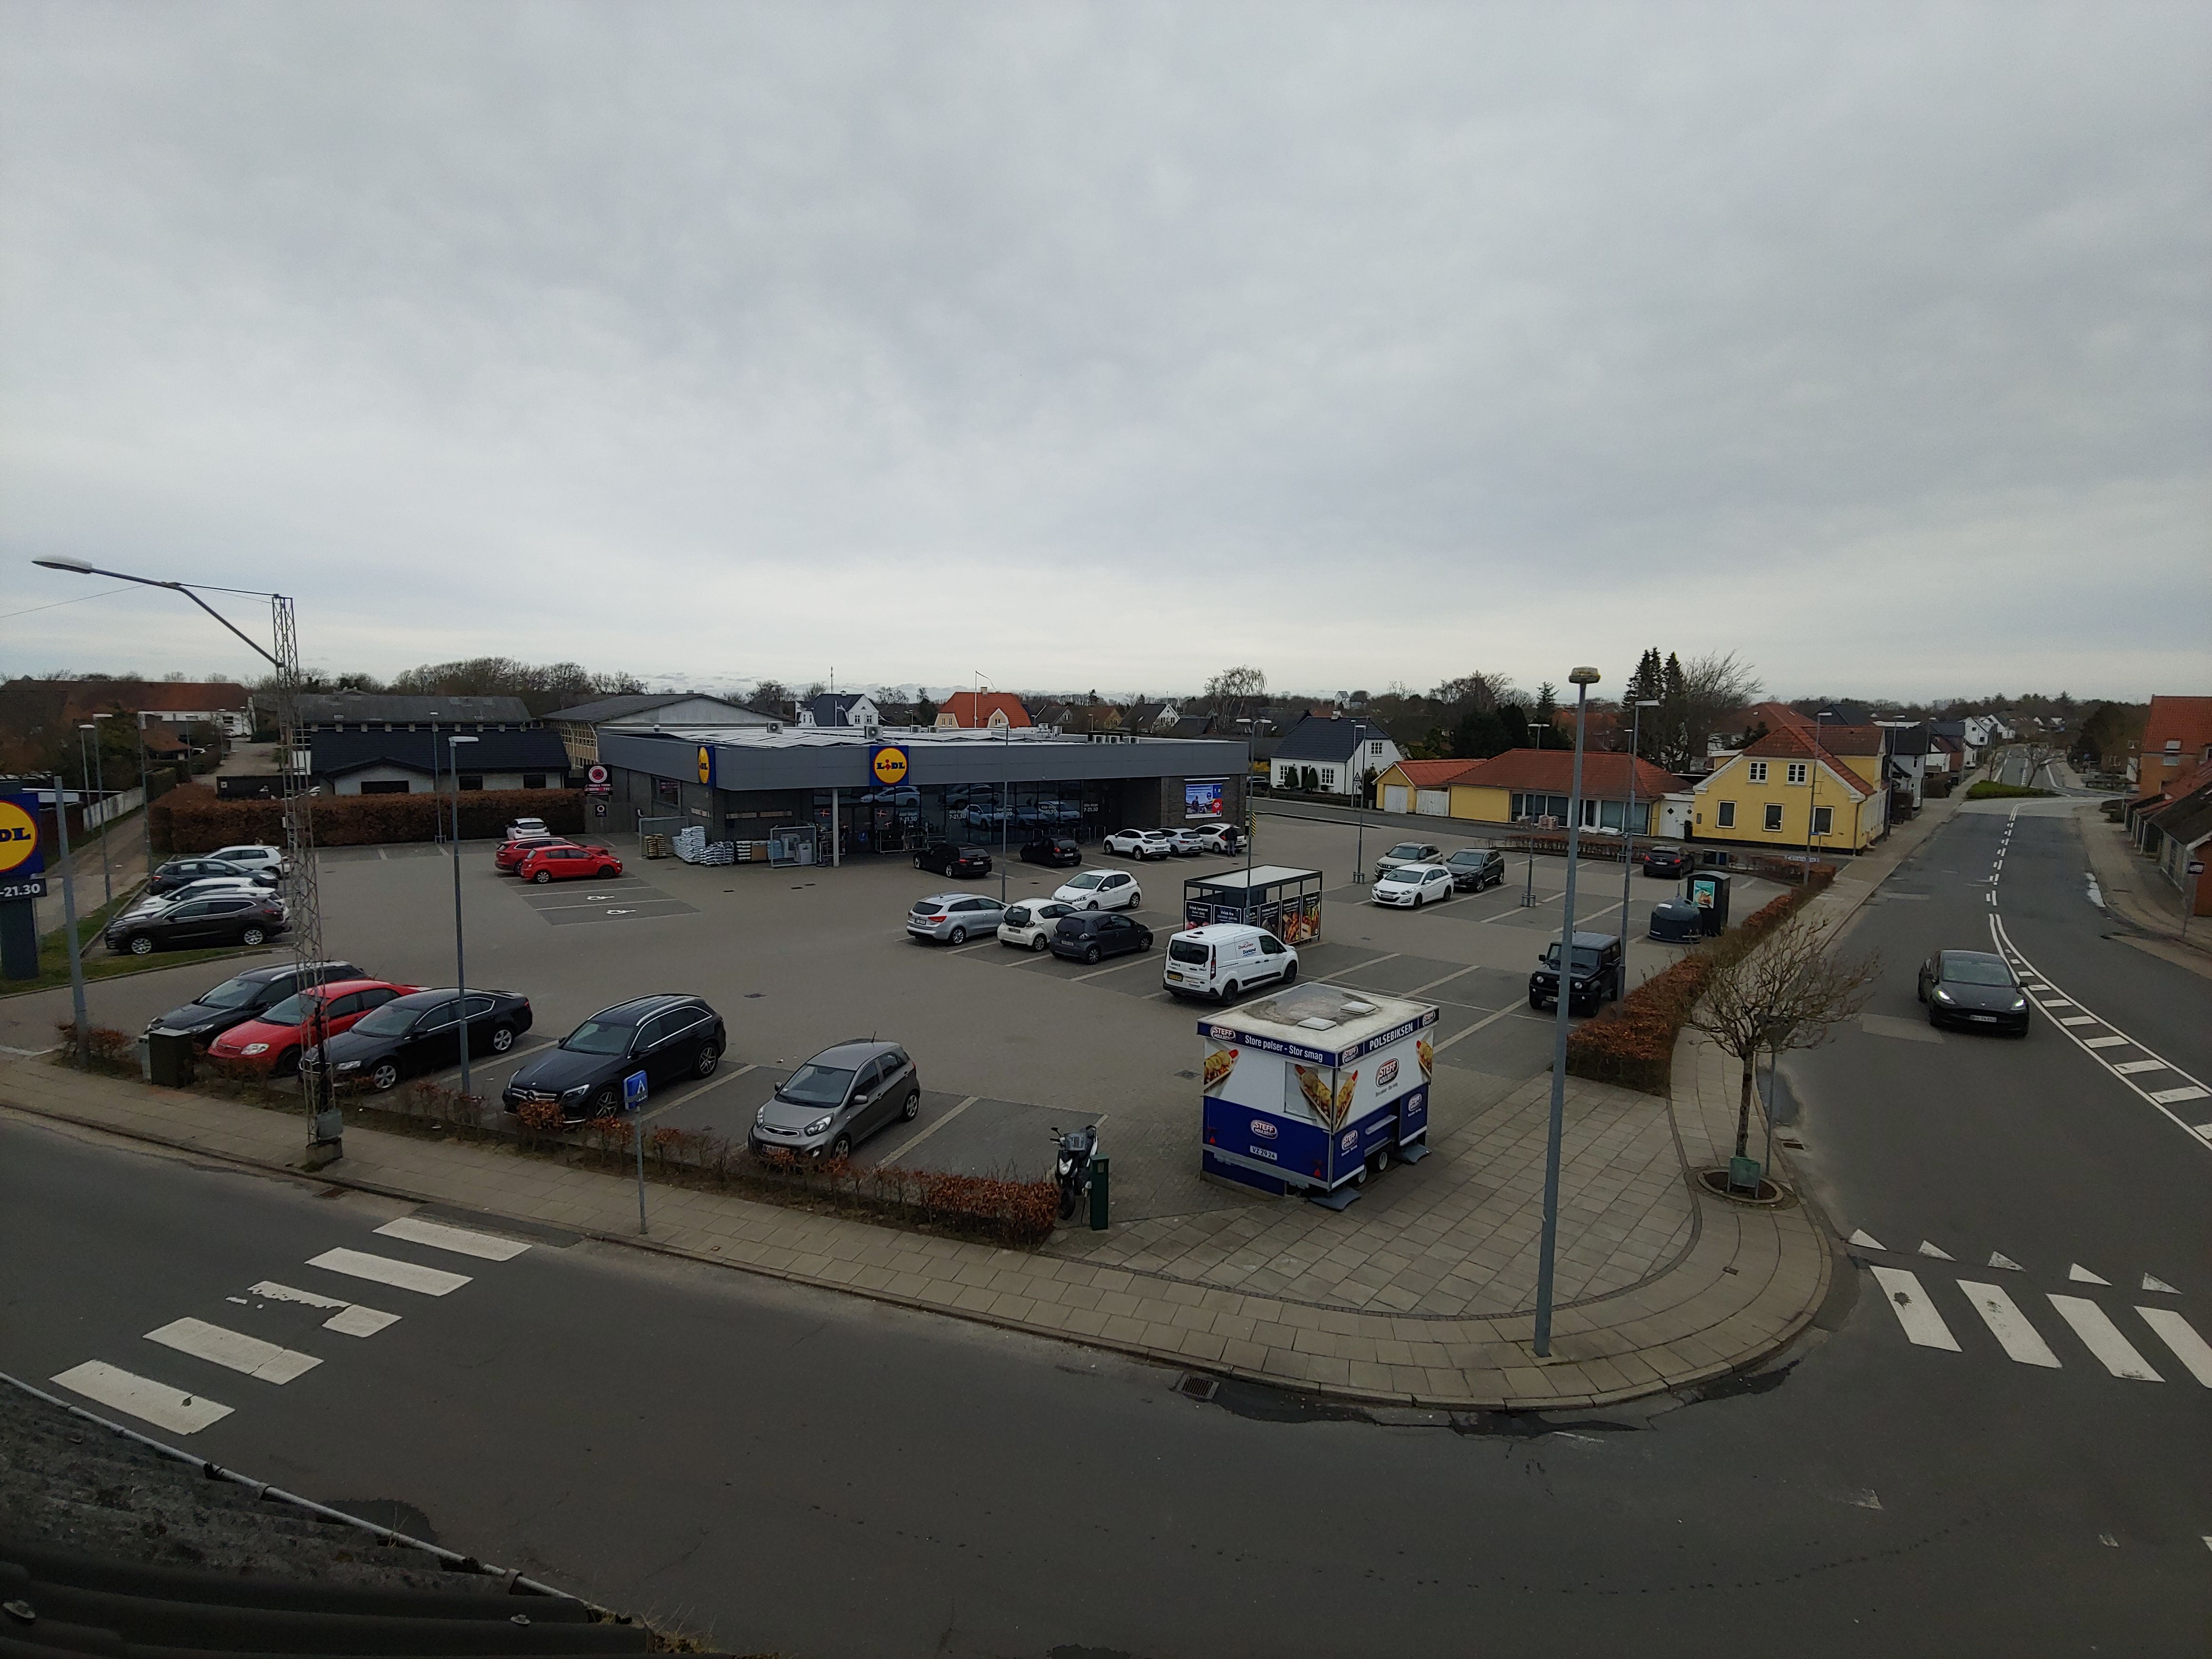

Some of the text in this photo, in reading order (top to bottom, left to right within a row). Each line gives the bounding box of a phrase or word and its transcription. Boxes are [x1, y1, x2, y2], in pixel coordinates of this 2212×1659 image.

[0, 827, 31, 842] DL
[0, 883, 41, 897] -21.30
[1212, 1026, 1232, 1037] STEFF
[1369, 1022, 1413, 1051] PØLSEBIKSEN
[1245, 1035, 1262, 1047] Store
[1263, 1040, 1284, 1051] pølser
[1289, 1045, 1303, 1056] Stor
[1304, 1050, 1323, 1063] smag
[1379, 1060, 1397, 1077] STEFF
[1254, 1122, 1274, 1132] STEFF
